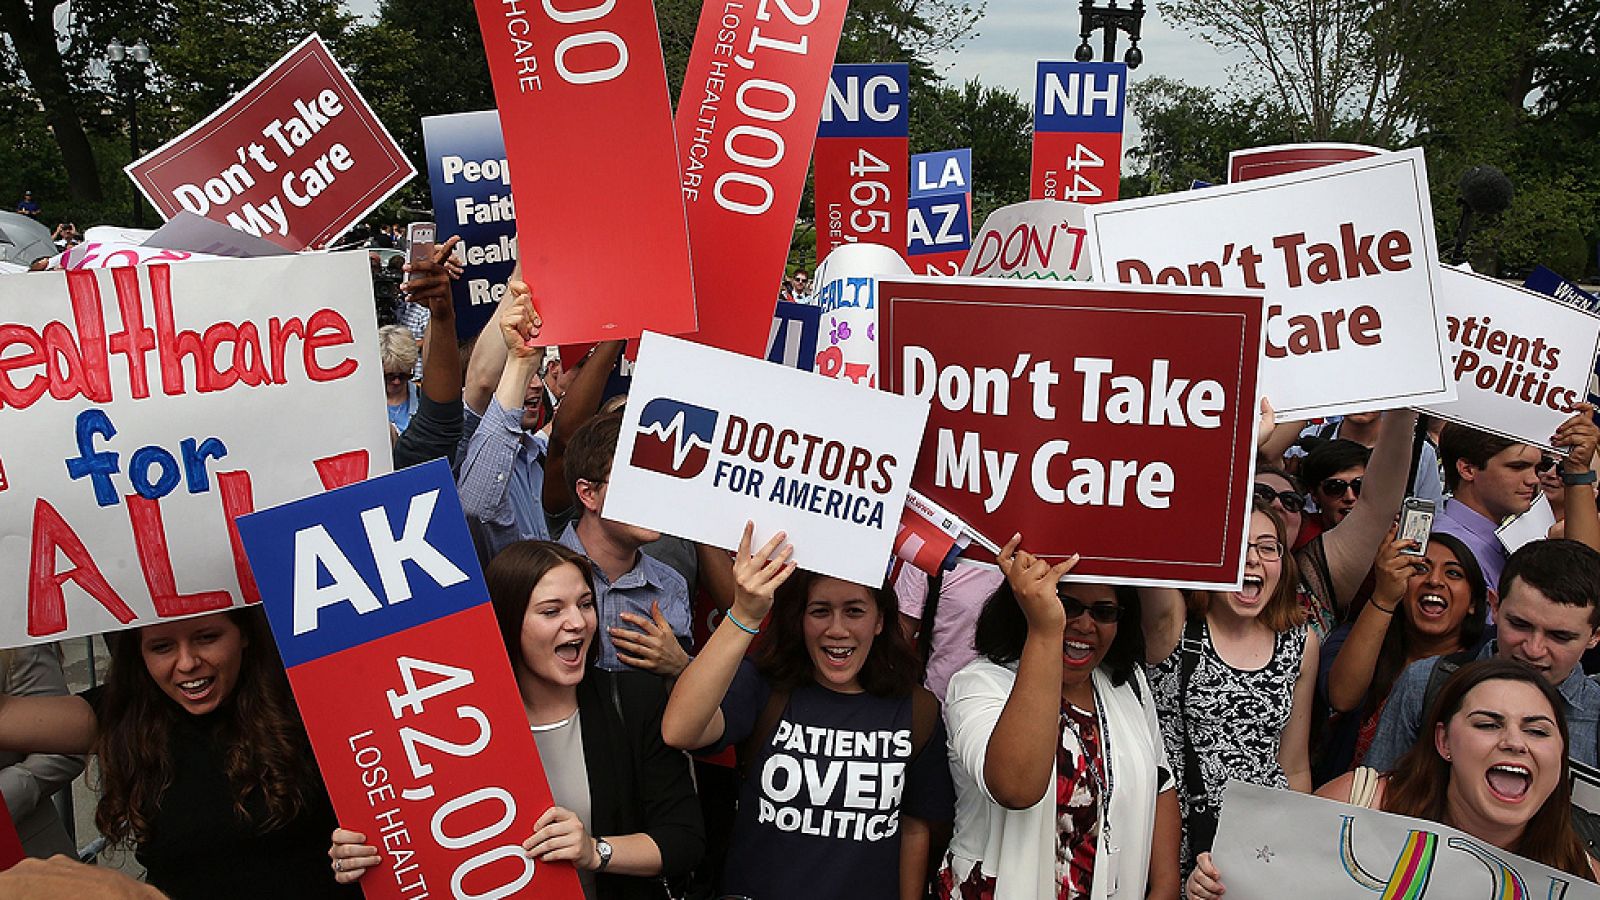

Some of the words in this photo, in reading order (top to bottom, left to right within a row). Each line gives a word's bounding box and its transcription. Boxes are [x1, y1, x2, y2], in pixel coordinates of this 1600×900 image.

[714, 2, 744, 57] LOSE
[821, 75, 900, 122] NC
[1043, 73, 1119, 117] NH
[172, 142, 278, 216] Don't
[262, 89, 344, 157] Take
[682, 61, 729, 202] HEALTHCARE
[226, 196, 289, 237] My
[282, 143, 355, 207] Care
[918, 157, 965, 190] LA
[829, 204, 841, 237] LOSE
[907, 203, 963, 247] AZ
[971, 221, 1087, 276] DON'T
[1272, 221, 1412, 288] Take
[0, 264, 358, 409] ealthcare
[902, 345, 1059, 420] Don't
[1073, 357, 1226, 428] Take
[1454, 350, 1577, 413] Politics
[65, 408, 227, 506] for
[721, 414, 897, 494] DOCTORS
[935, 427, 1019, 514] My
[1030, 439, 1175, 508] Care
[713, 460, 764, 498] FOR
[769, 476, 884, 529] AMERICA
[294, 488, 470, 636] AK
[349, 730, 396, 807] LOSE
[772, 719, 912, 758] PATIENTS
[386, 655, 535, 900] 42,00
[761, 753, 906, 810] OVER
[758, 797, 899, 842] POLITICS
